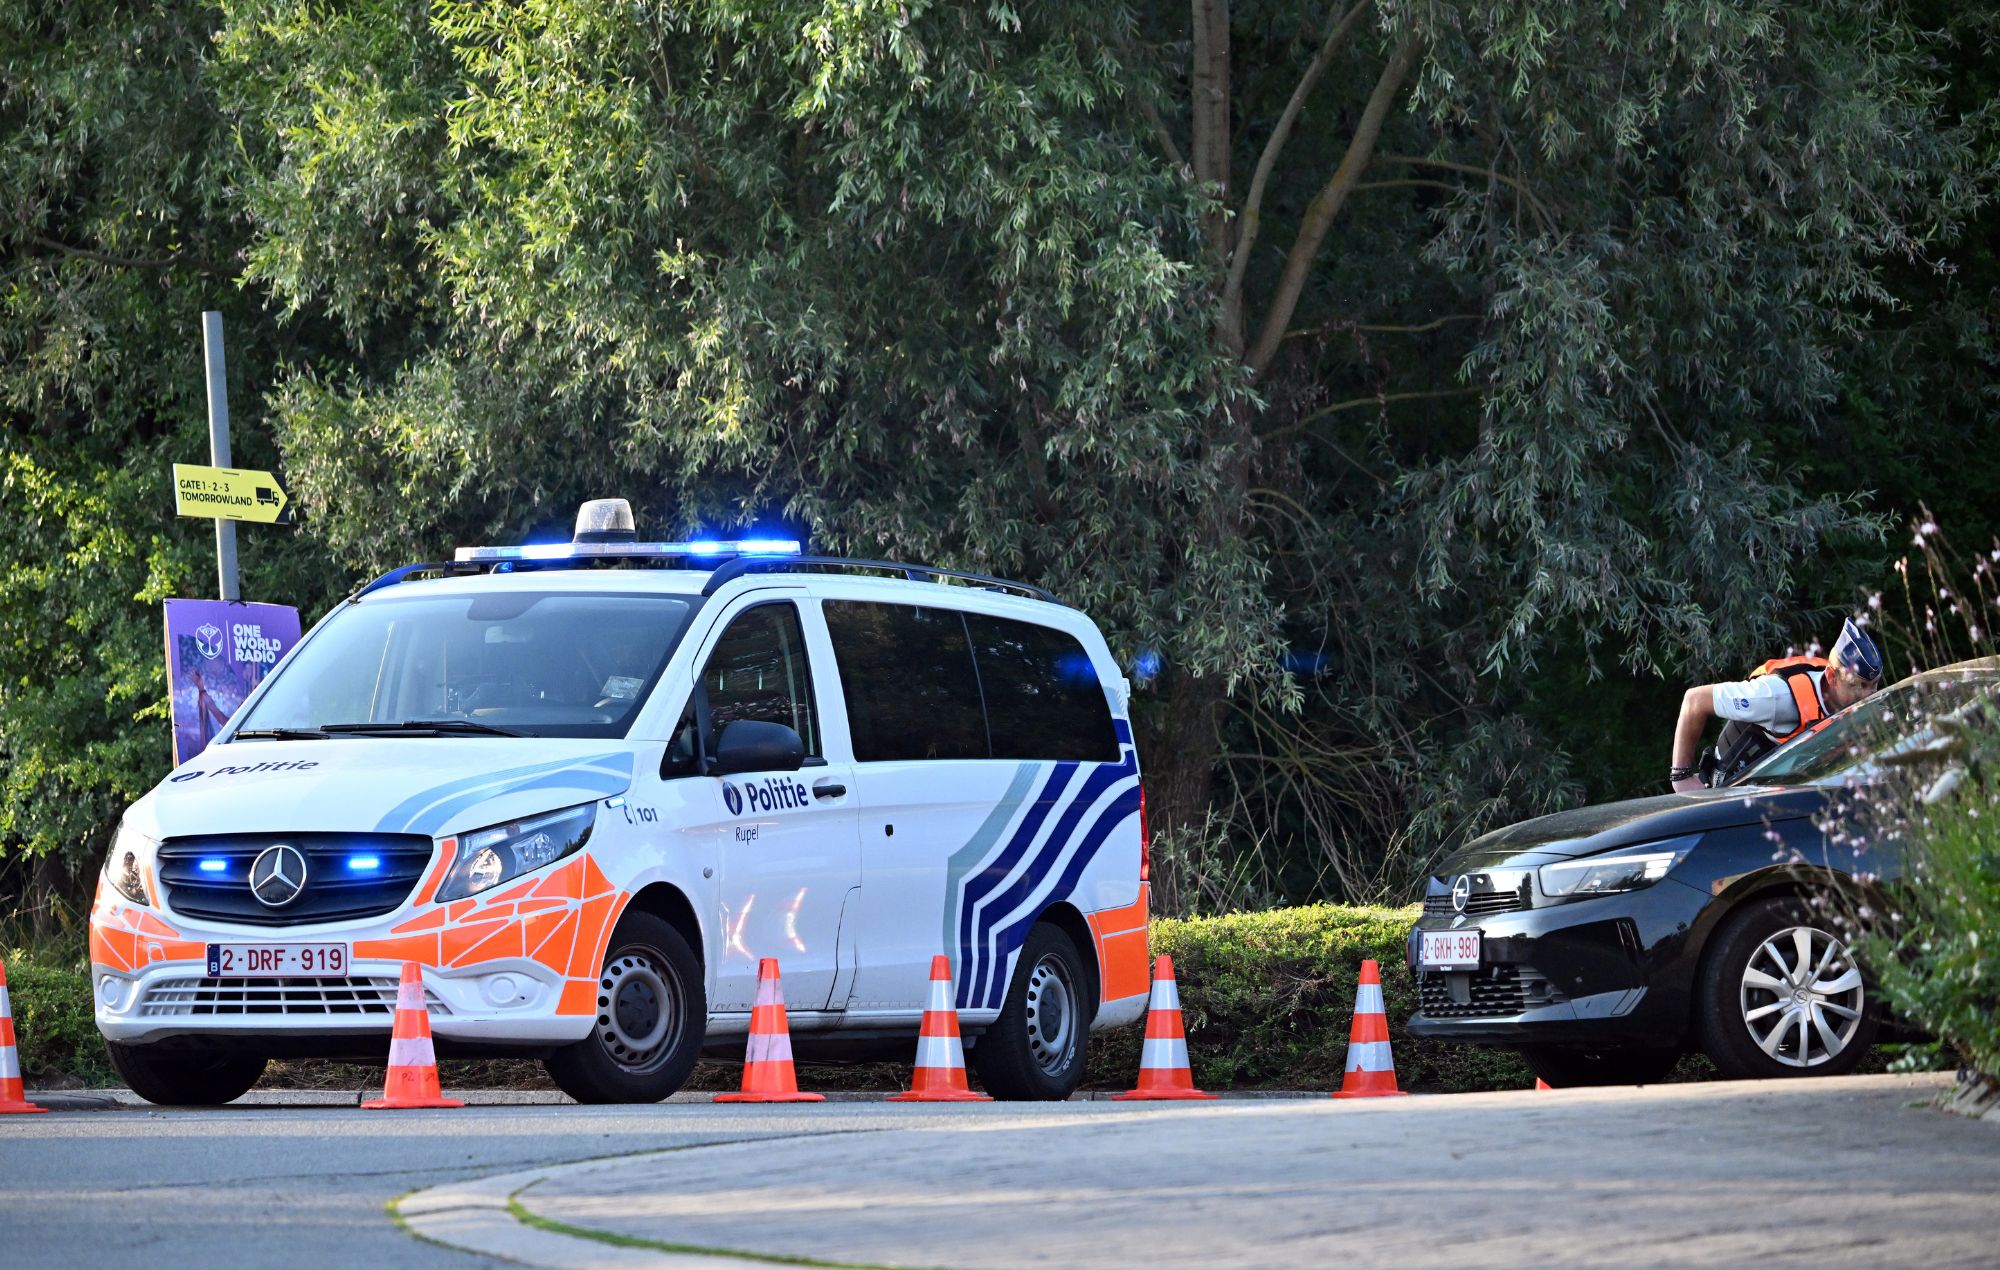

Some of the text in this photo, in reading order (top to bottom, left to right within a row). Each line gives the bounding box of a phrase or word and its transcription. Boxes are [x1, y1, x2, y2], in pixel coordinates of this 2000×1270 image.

[180, 480, 200, 490] GATE
[212, 482, 218, 491] 2
[224, 483, 229, 492] 3
[181, 492, 252, 506] TOMORROWLAND
[233, 624, 261, 638] ONE
[234, 636, 281, 651] WORLD
[235, 649, 276, 663] RADIO
[209, 760, 319, 777] Politie
[745, 777, 809, 812] Politie
[637, 808, 658, 822] 101
[736, 824, 759, 845] Rupel
[1424, 937, 1478, 959] 2-GKH-980
[211, 949, 342, 971] B 2-DRF-919
